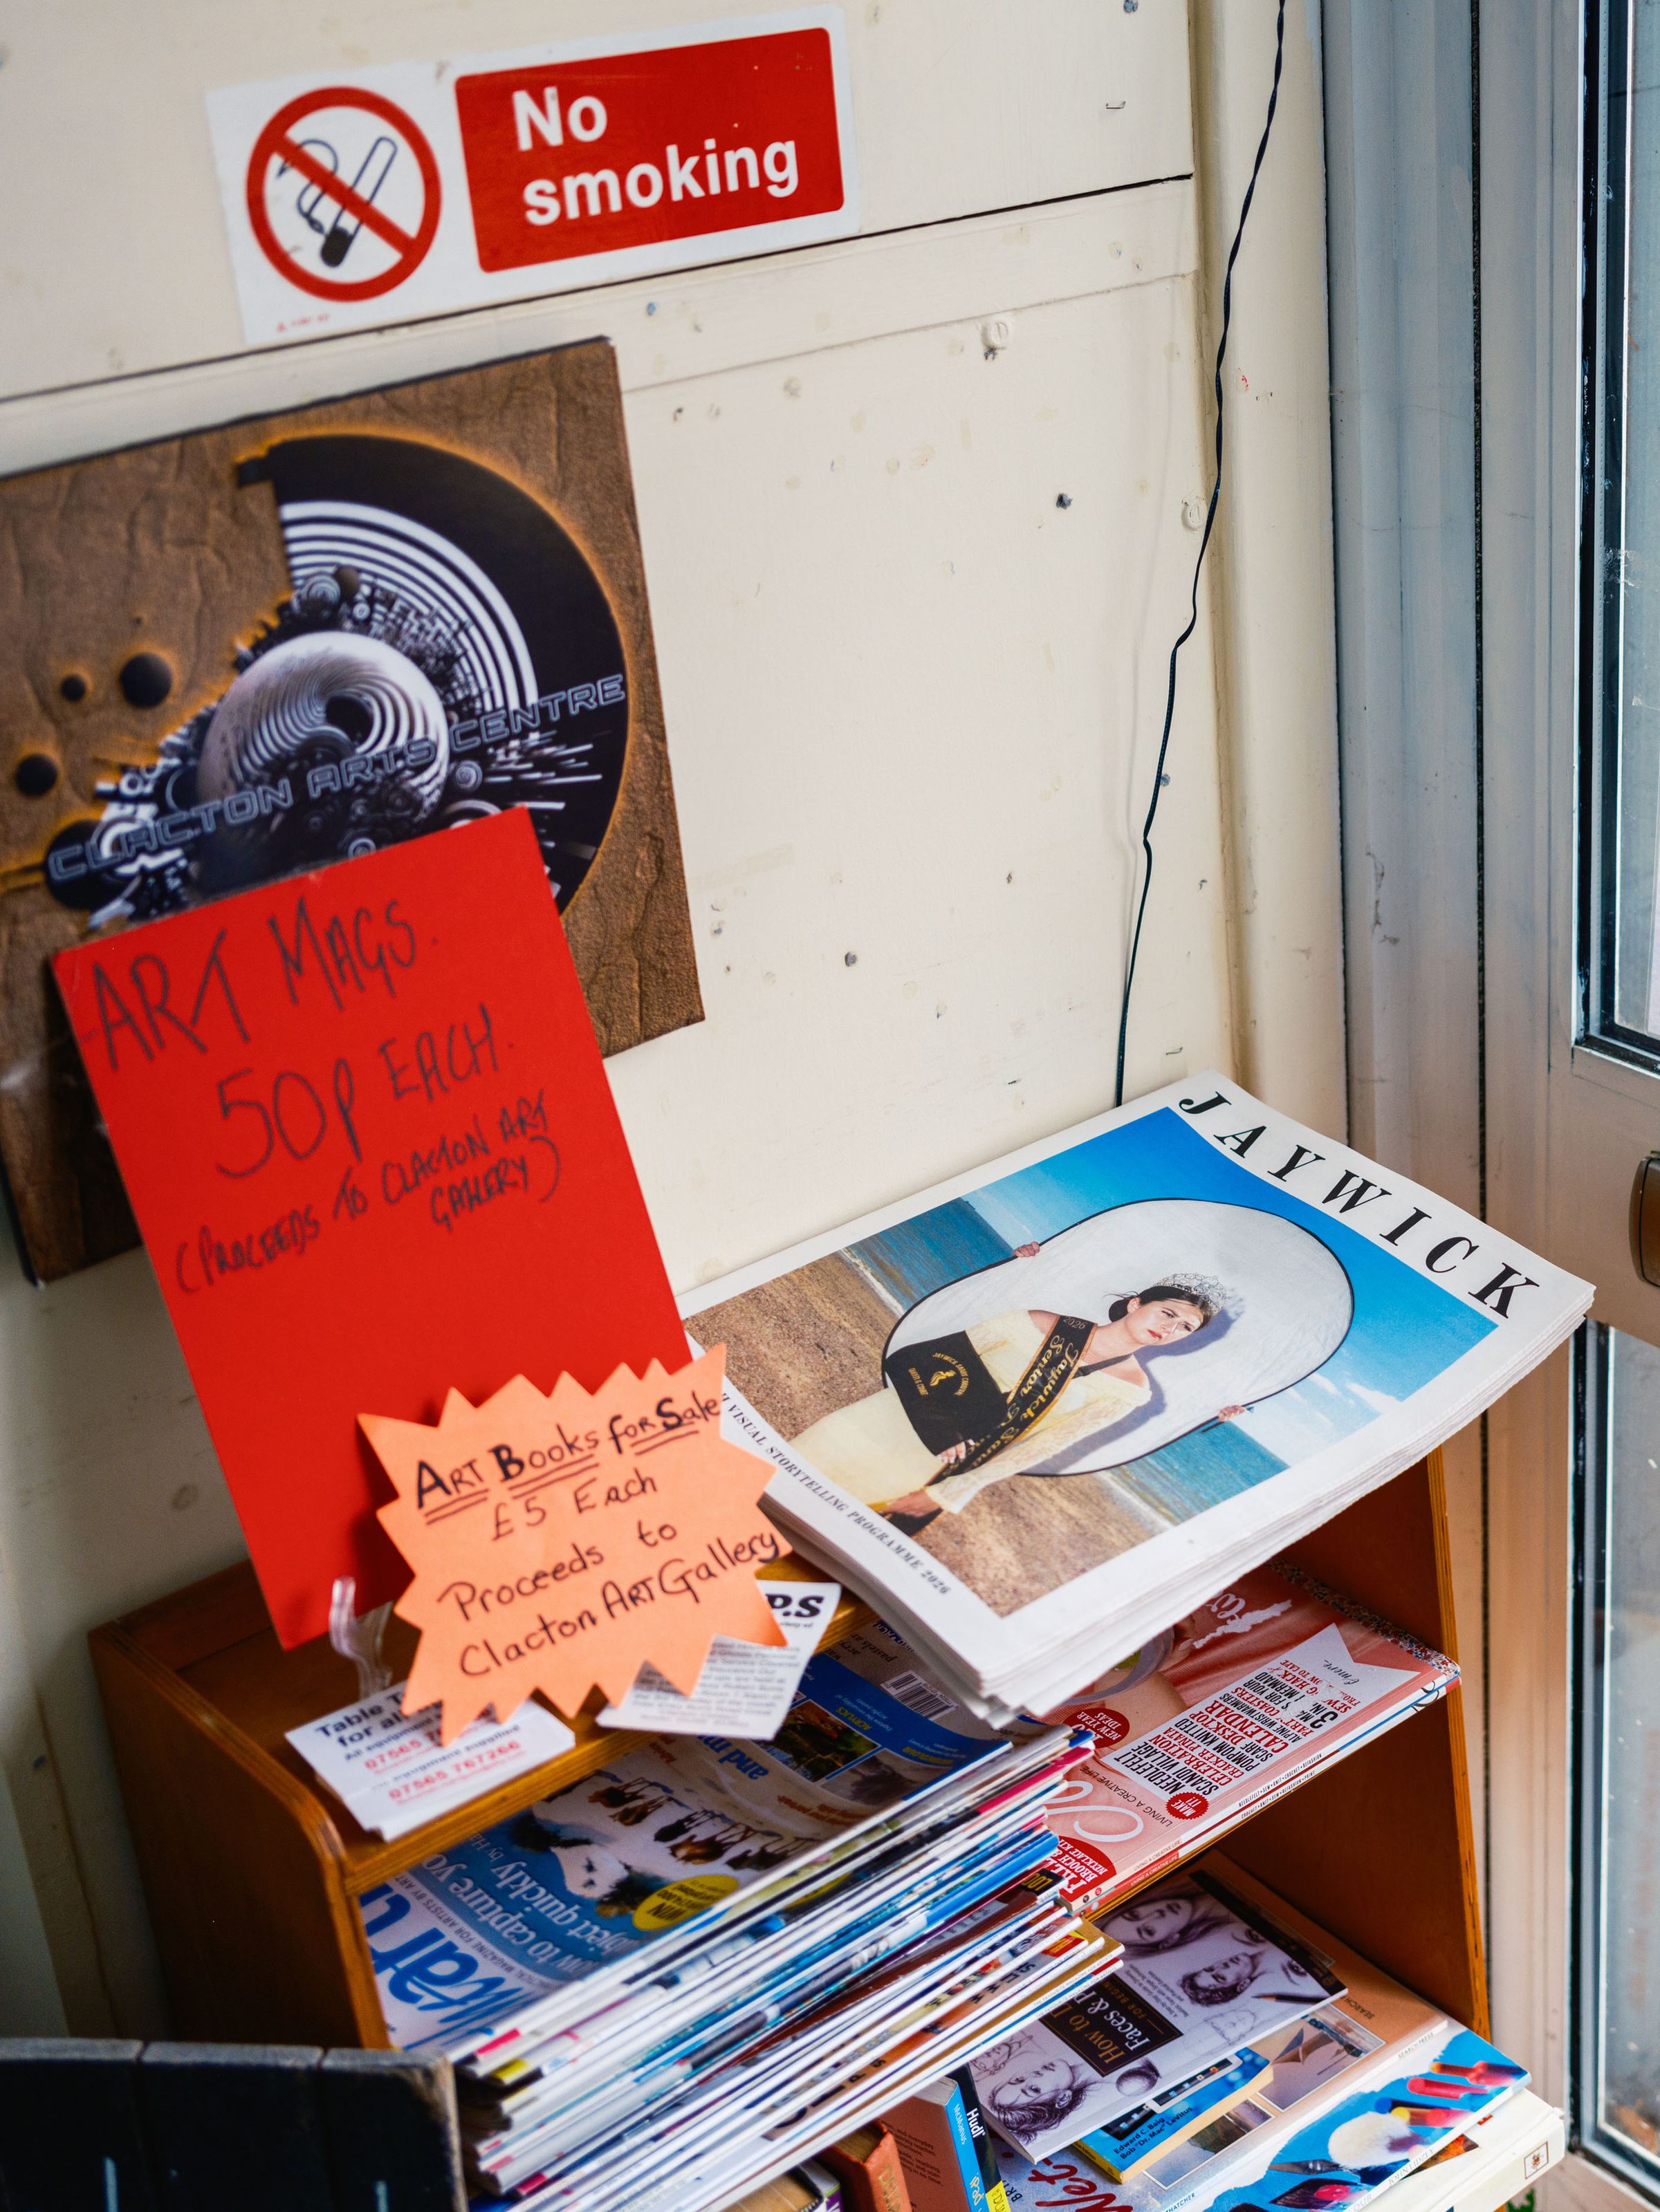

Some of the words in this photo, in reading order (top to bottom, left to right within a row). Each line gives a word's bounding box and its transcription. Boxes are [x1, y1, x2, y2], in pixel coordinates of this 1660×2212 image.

[513, 87, 607, 151] No
[523, 138, 800, 225] smoking
[46, 780, 293, 881] CLACTON
[308, 739, 438, 798] ARTS
[450, 674, 627, 753] CENTRE
[92, 929, 250, 1070] ART
[1179, 1091, 1540, 1319] JAYWICK
[1063, 1316, 1088, 1330] 2026
[656, 1391, 720, 1431] Sale
[573, 1467, 658, 1513] Each
[728, 1404, 768, 1446] VISUAL
[766, 1445, 849, 1512] STORYTELLING
[847, 1509, 924, 1569] PROGRAMME
[921, 1569, 951, 1595] 2026
[436, 1542, 605, 1622] Proceeds
[637, 1519, 677, 1548] to
[459, 1609, 598, 1677] Clacton
[835, 1639, 863, 1655] acry
[857, 1639, 898, 1664] pastels
[1278, 1658, 1300, 1672] CAPE
[1297, 1669, 1311, 1677] TO
[1242, 1678, 1270, 1695] YOUR
[1253, 1670, 1301, 1699] MERMAID
[1263, 1691, 1286, 1705] FOR
[1218, 1691, 1278, 1729] WRISTWARMERS
[1230, 1685, 1281, 1717] COASTERS
[315, 1701, 384, 1738] Table
[834, 1703, 872, 1733] ACRYLICS
[1075, 1711, 1100, 1727] YEAR
[1093, 1711, 1122, 1729] IDEAS
[1094, 1723, 1121, 1740] NEW
[1172, 1717, 1220, 1747] KNITTED
[1188, 1709, 1246, 1745] DESKTOP
[1201, 1698, 1291, 1754] CALENDAR
[1307, 1709, 1340, 1729] 3
[338, 1727, 373, 1748] for
[365, 1715, 434, 1754] equipment
[1159, 1726, 1202, 1752] PIÑATA
[1271, 1724, 1303, 1743] ALPINE
[717, 1746, 771, 1785] and
[1130, 1740, 1181, 1772] VILLAGE
[1147, 1733, 1235, 1787] CELEBRATION
[1195, 1747, 1246, 1779] CRACKER
[1210, 1740, 1261, 1772] POMPOM
[1239, 1740, 1274, 1762] SCARF
[1078, 1765, 1100, 1778] LIFE
[1112, 1749, 1186, 1794] NEEDLEFELT
[1170, 1765, 1221, 1796] SCANDI
[1238, 1790, 1260, 1807] NEEDLEFELT
[1272, 1776, 1282, 1786] KNIT
[1284, 1765, 1300, 1779] CROCHET
[1302, 1752, 1322, 1768] REFASHION
[1094, 1775, 1138, 1803] CREATIVE
[1133, 1800, 1146, 1808] A
[1184, 1795, 1204, 1807] IT!
[1241, 1805, 1257, 1819] CROCHET
[1271, 1792, 1279, 1800] SEW
[1281, 1778, 1302, 1794] REFASHION
[1303, 1769, 1316, 1780] PRINT
[1140, 1805, 1175, 1827] LIVING
[1169, 1799, 1198, 1816] MAKE
[418, 1846, 468, 1884] yo
[483, 1845, 505, 1861] by
[1055, 1854, 1099, 1882] BROOCH
[1069, 1848, 1109, 1875] NECKLACE
[1133, 1859, 1147, 1871] LIVING
[1152, 1845, 1172, 1860] CREATIVE
[1171, 1839, 1181, 1848] LIFE
[1148, 1861, 1167, 1875] CREATIVE
[1166, 1855, 1178, 1864] LIFE
[393, 1872, 416, 1890] ART
[409, 1887, 427, 1900] BY
[483, 1851, 587, 1935] quickly
[422, 1897, 458, 1928] ARTISTS
[443, 1868, 544, 1952] capture
[452, 1925, 474, 1943] FOR
[469, 1937, 515, 1976] MAGAZINE
[522, 1937, 563, 1966] to
[1082, 1996, 1112, 2017] &
[1126, 2002, 1148, 2019] FOR
[1343, 1997, 1374, 2020] SEARCH
[1063, 2012, 1091, 2032] to
[1096, 2008, 1151, 2051] Faces
[1078, 2027, 1125, 2064] How
[953, 2103, 968, 2145] McManus
[966, 2108, 984, 2138] Hudl
[1113, 2132, 1141, 2154] Edward
[1139, 2126, 1149, 2136] C.
[1147, 2115, 1165, 2131] Baig
[1120, 2146, 1136, 2159] Bob
[1165, 2105, 1192, 2126] LeVitus
[969, 2172, 984, 2206] iPad
